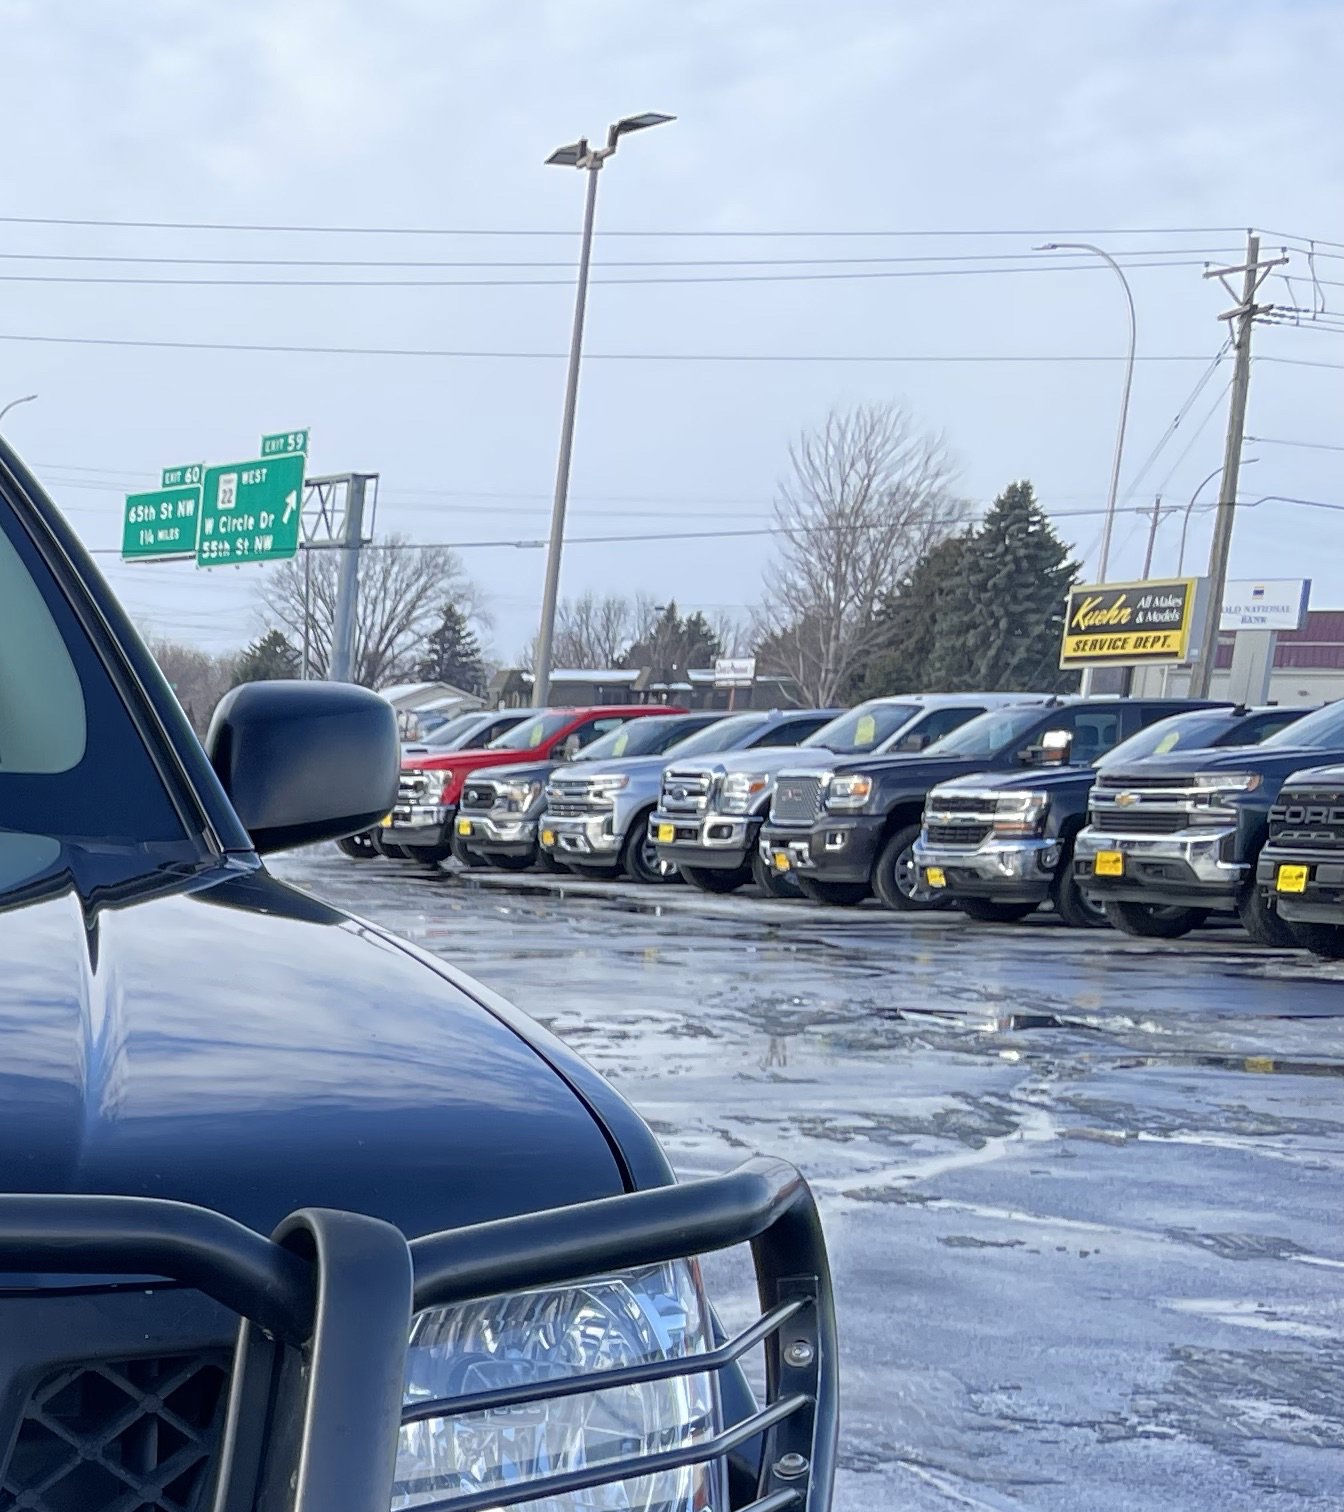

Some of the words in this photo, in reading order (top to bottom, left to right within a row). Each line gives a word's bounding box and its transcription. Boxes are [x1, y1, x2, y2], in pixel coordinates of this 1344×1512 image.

[264, 438, 284, 453] EXIT
[287, 433, 304, 451] 59
[164, 471, 182, 484] EXIT
[184, 466, 200, 483] 60
[242, 468, 267, 485] WEST
[221, 488, 233, 505] 22
[129, 505, 156, 523] 65th
[160, 502, 173, 520] St
[177, 499, 195, 518] NW
[204, 517, 214, 535] W
[219, 514, 255, 534] Circle
[260, 511, 275, 529] Dr
[157, 527, 180, 541] MILES
[202, 540, 230, 559] 55th
[235, 538, 249, 555] St
[254, 534, 273, 554] NW
[1071, 594, 1132, 631] Kuehn
[1137, 595, 1152, 609] All
[1153, 594, 1183, 608] Makes
[1135, 611, 1144, 624] &
[1145, 609, 1180, 622] Models
[1243, 605, 1290, 613] NATIONAL
[1241, 615, 1268, 624] BANK
[1073, 636, 1130, 652] SERVICE
[1133, 634, 1171, 649] DEPT.
